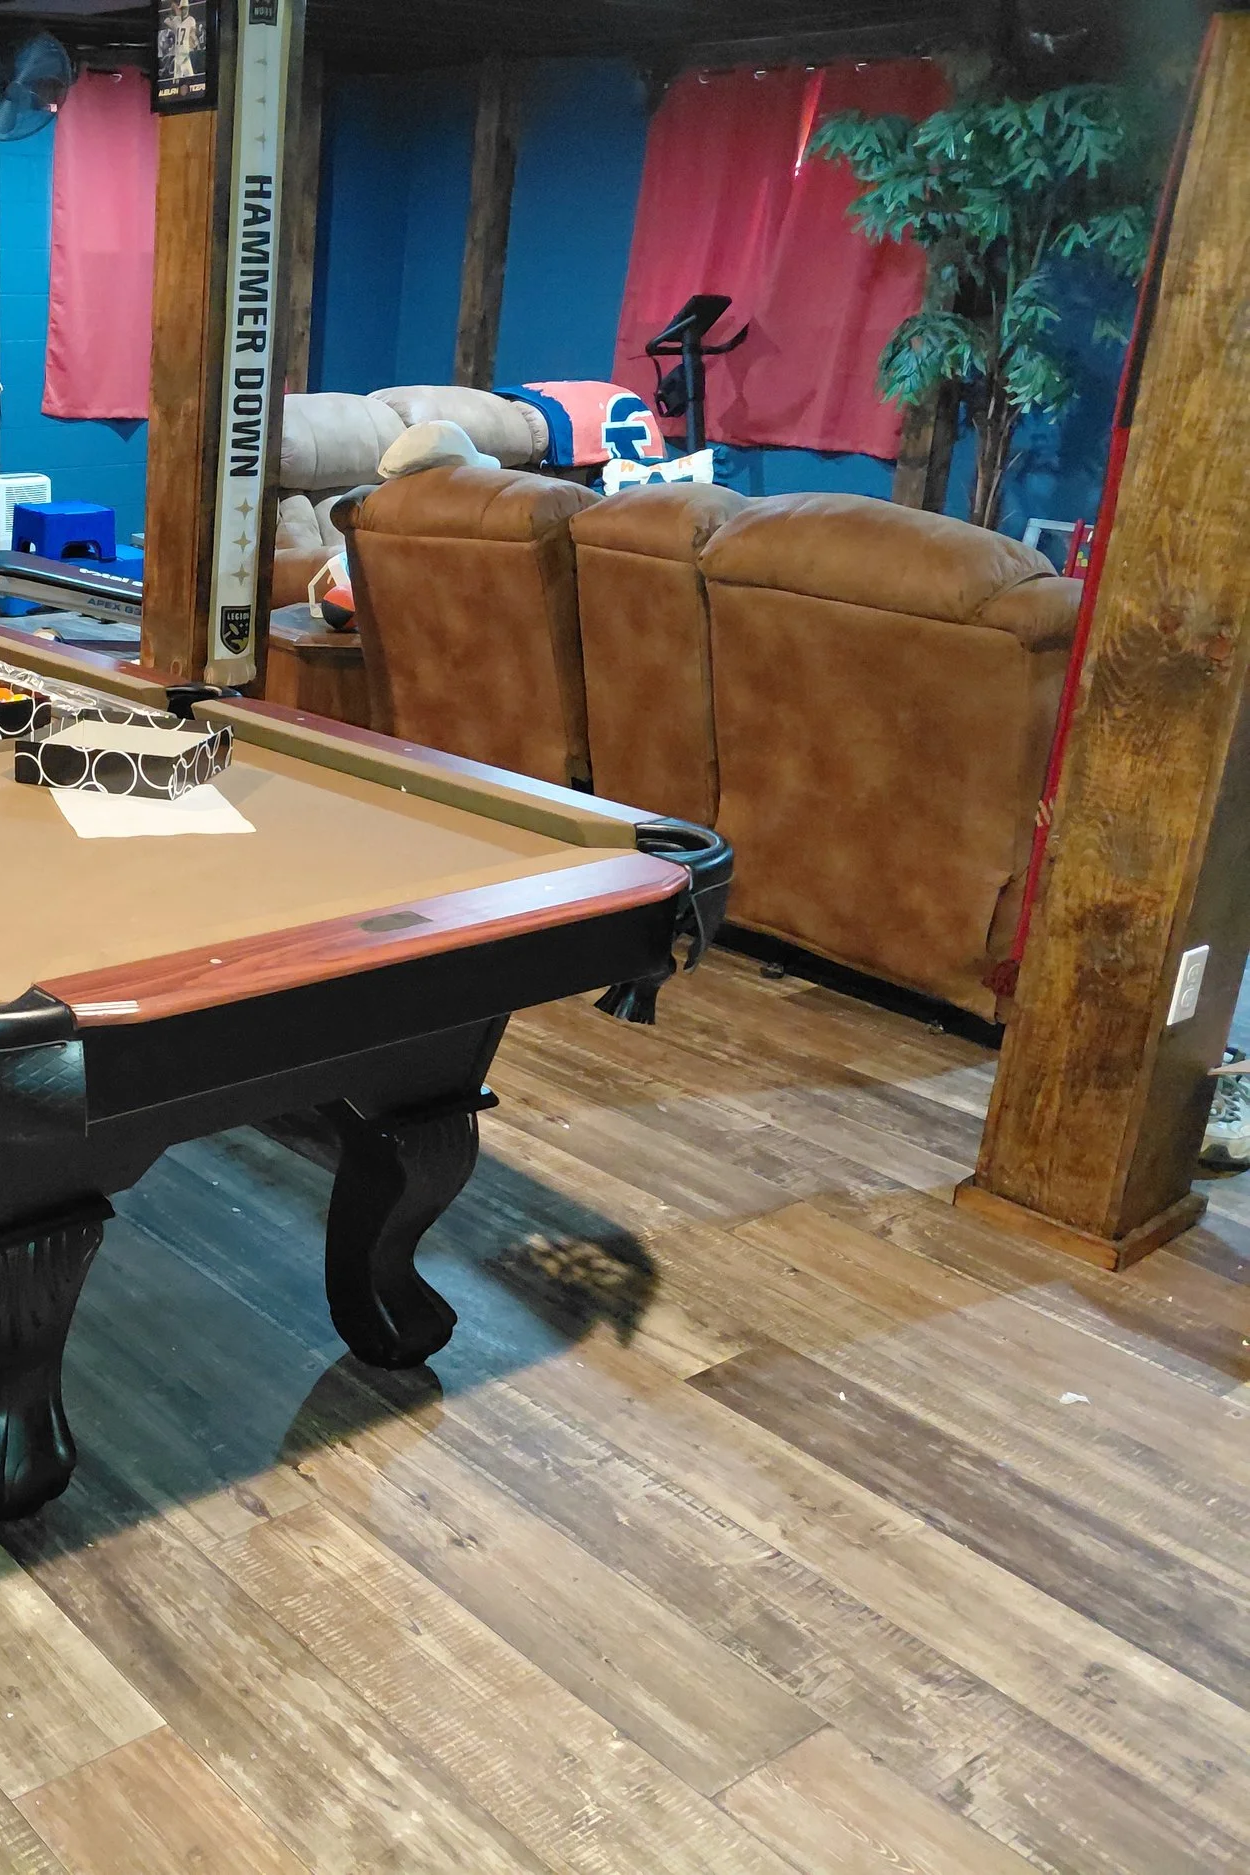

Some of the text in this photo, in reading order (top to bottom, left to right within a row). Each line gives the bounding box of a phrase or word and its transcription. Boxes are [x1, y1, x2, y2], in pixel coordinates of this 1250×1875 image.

[230, 175, 273, 477] HAMMER DOWN
[87, 598, 120, 611] APEX
